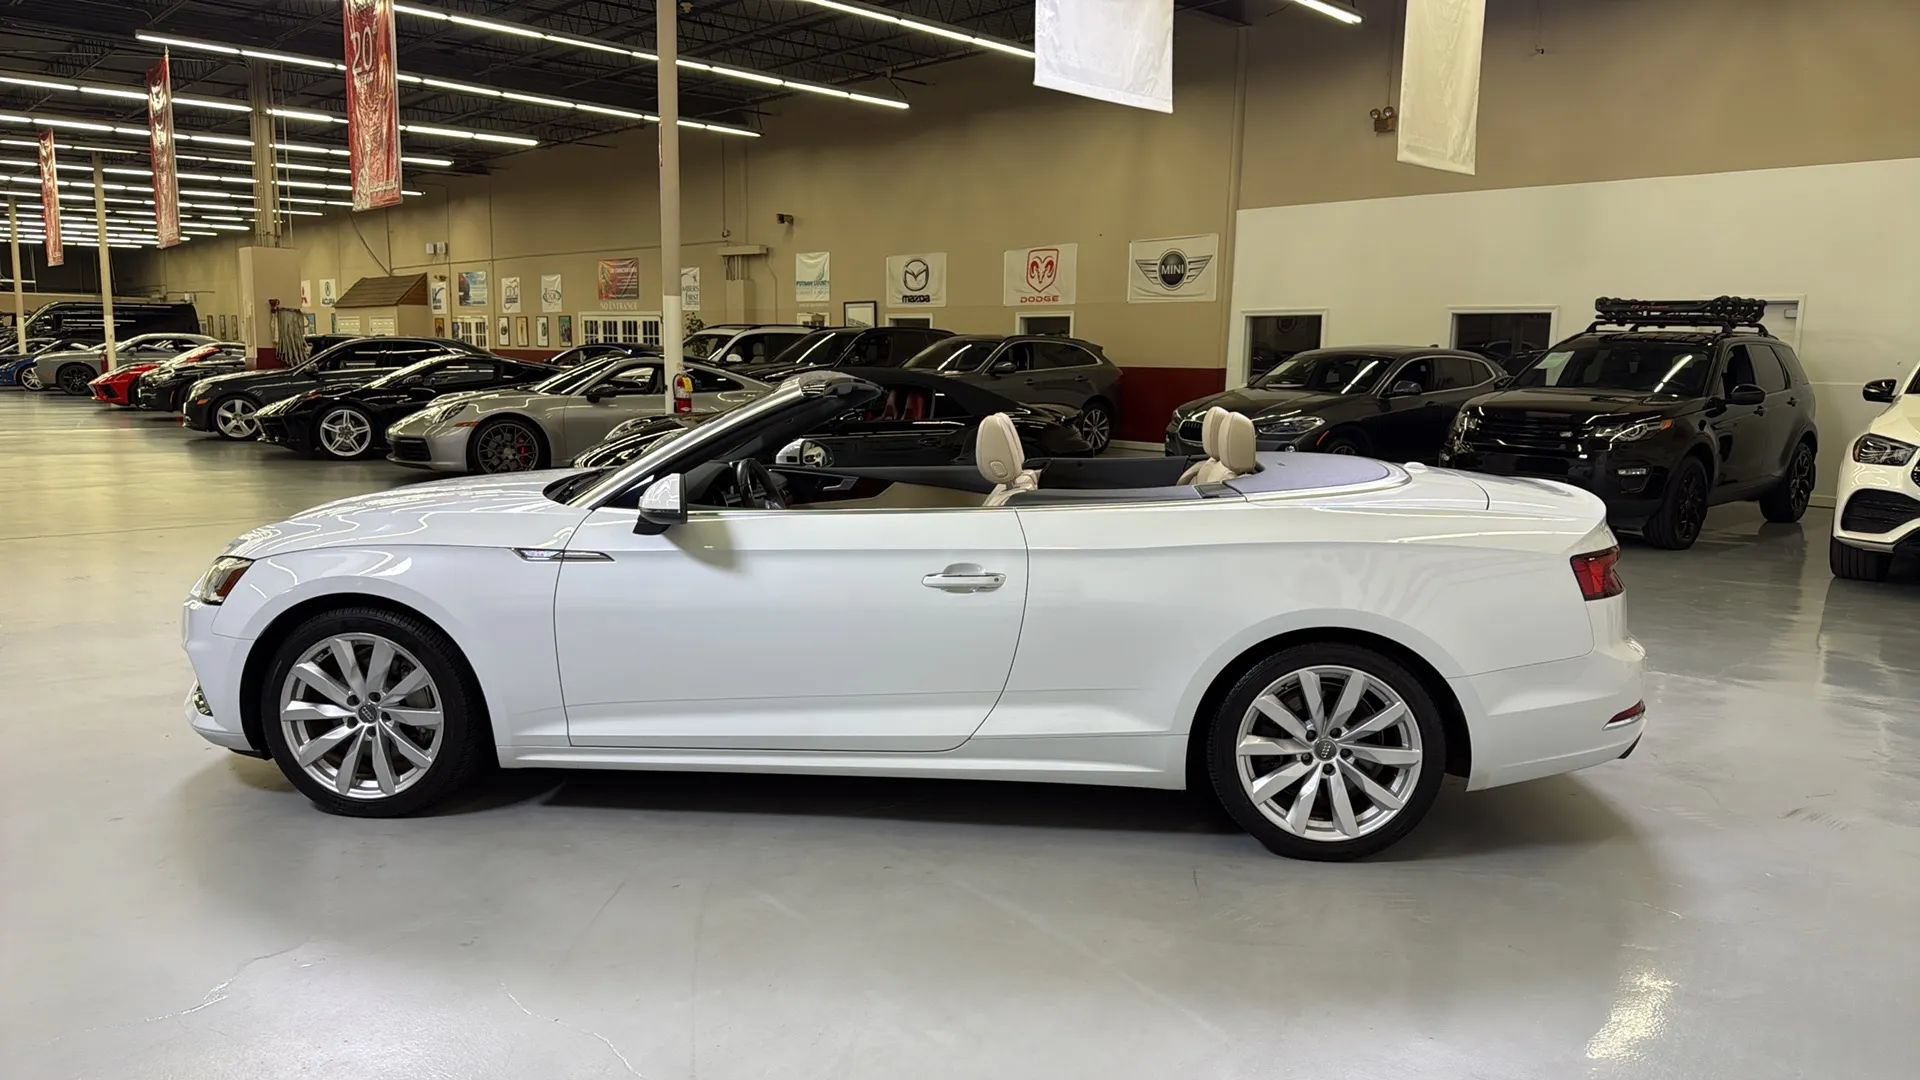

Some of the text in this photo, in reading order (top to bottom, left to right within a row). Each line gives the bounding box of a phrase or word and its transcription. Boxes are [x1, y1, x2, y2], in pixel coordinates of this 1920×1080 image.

[1161, 264, 1184, 275] MINI
[902, 294, 931, 303] mazda
[1020, 295, 1060, 304] DODGE
[600, 302, 638, 310] NO ENTRANCE
